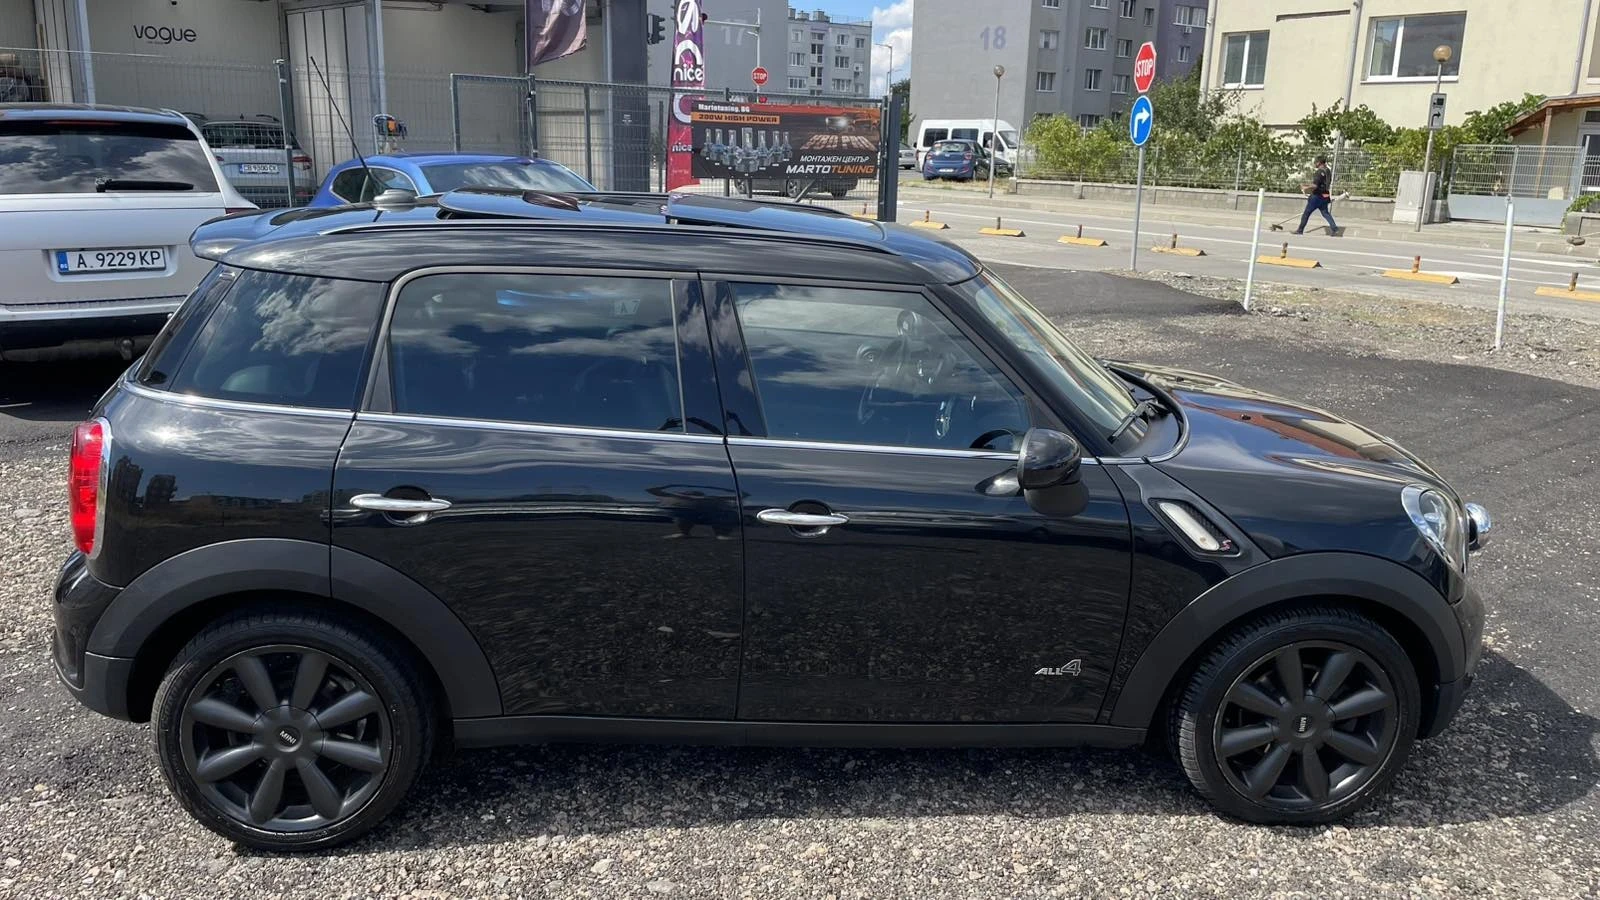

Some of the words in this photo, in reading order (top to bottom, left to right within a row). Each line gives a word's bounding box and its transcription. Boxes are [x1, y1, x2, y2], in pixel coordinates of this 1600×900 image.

[133, 25, 197, 45] vogue
[980, 25, 1006, 51] 18
[673, 64, 703, 82] nice
[753, 72, 767, 81] STOP
[1136, 58, 1154, 78] STOP
[800, 155, 843, 163] МОНТАЖЕН
[95, 252, 136, 268] 9229
[139, 250, 161, 265] KP
[279, 730, 297, 745] MINI
